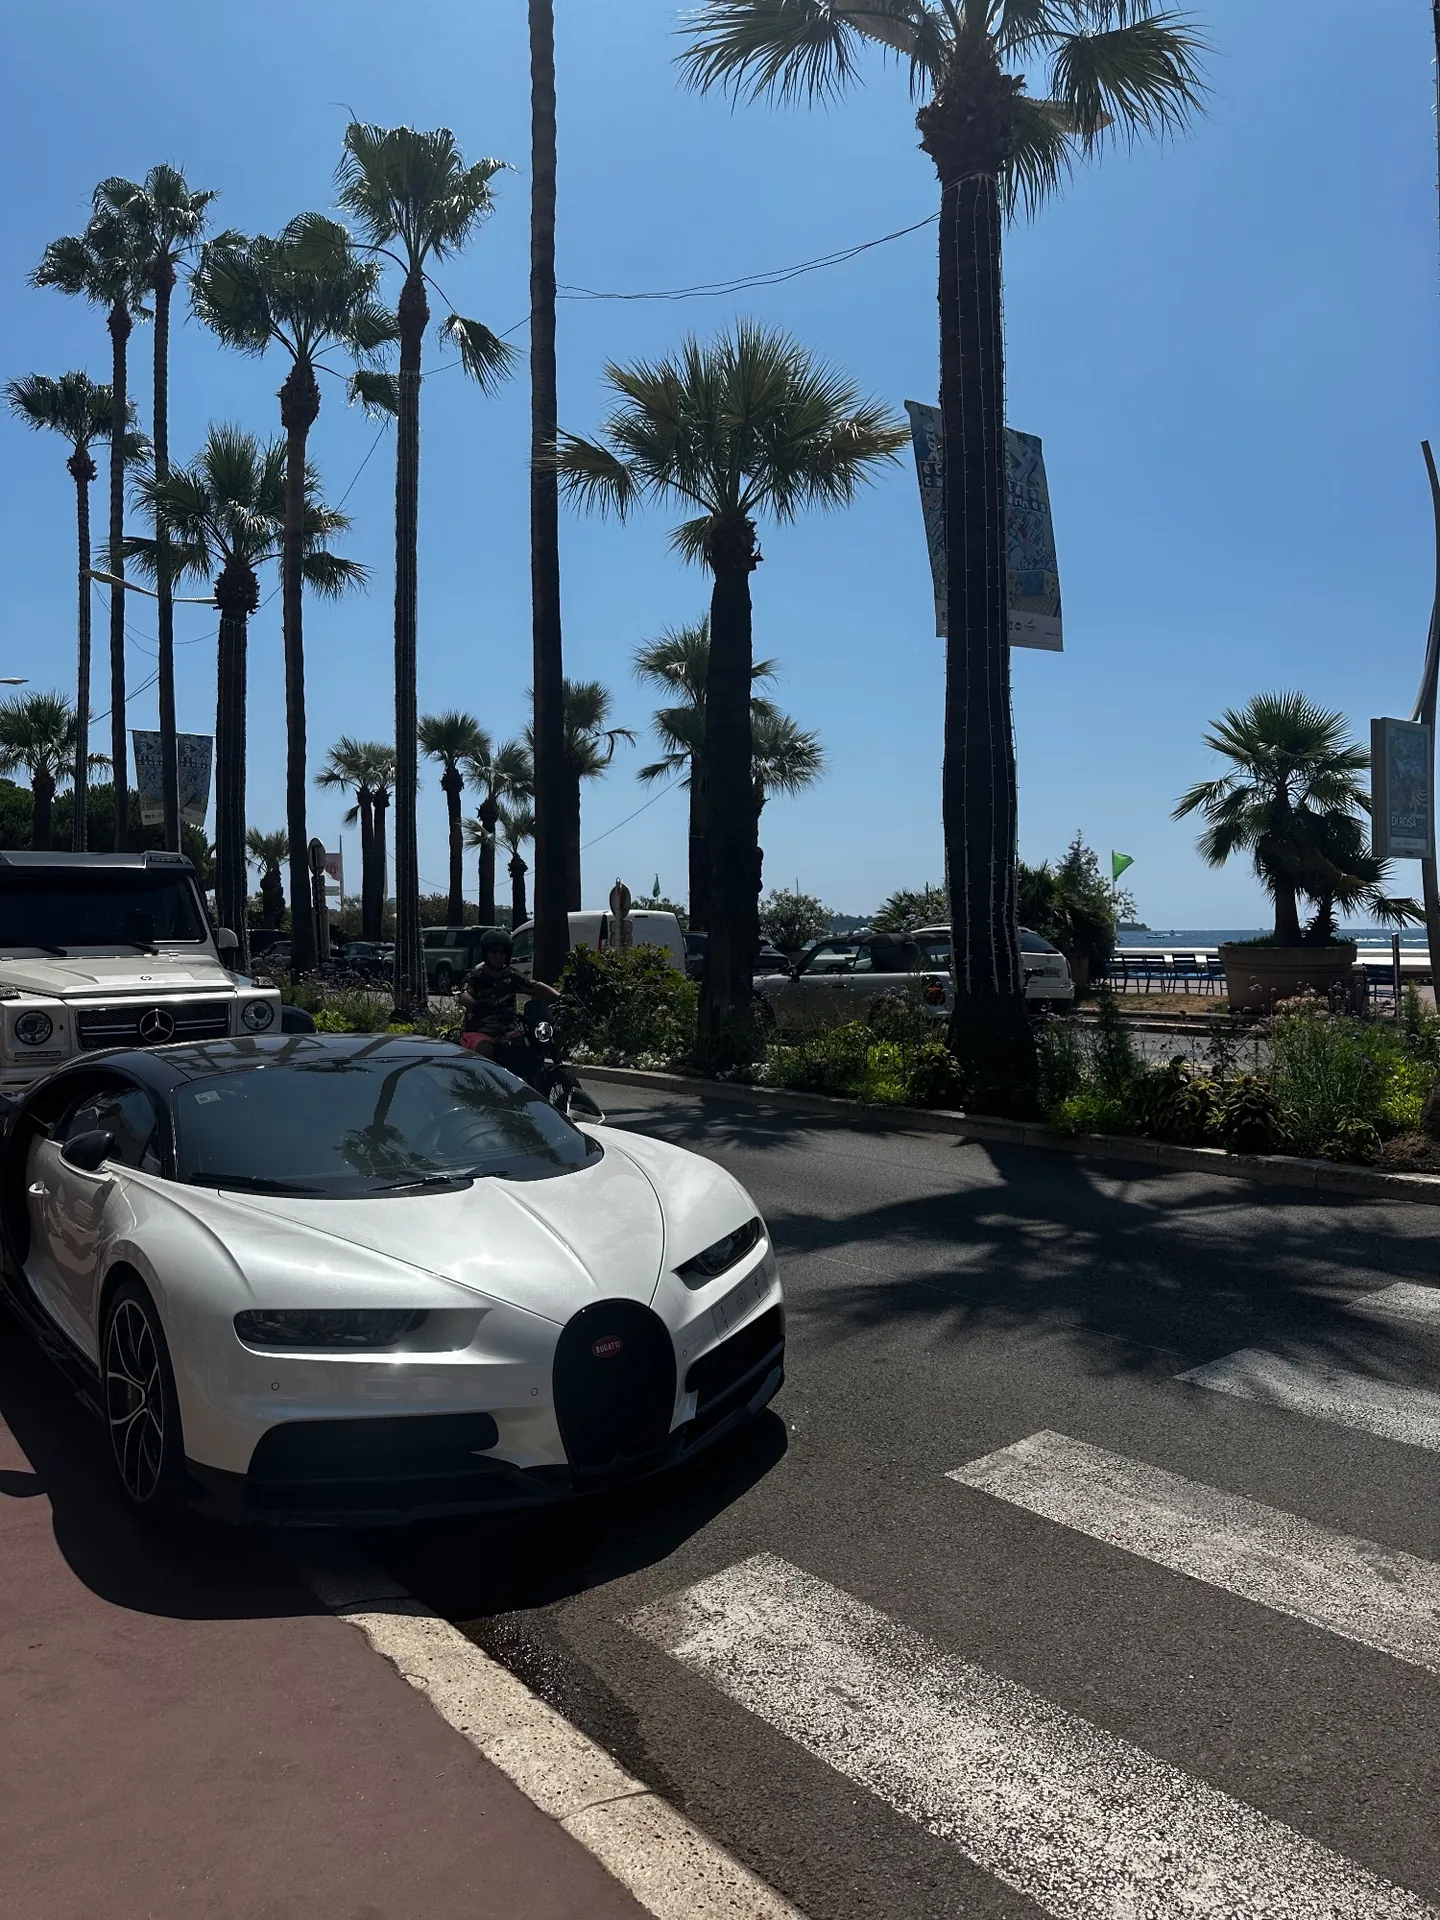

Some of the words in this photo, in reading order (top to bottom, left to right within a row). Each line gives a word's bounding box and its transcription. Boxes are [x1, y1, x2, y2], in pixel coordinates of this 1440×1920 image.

[1007, 494, 1046, 513] annes
[1391, 816, 1399, 827] DI
[1399, 816, 1417, 828] ROSA
[595, 1341, 620, 1353] BUGATTI
